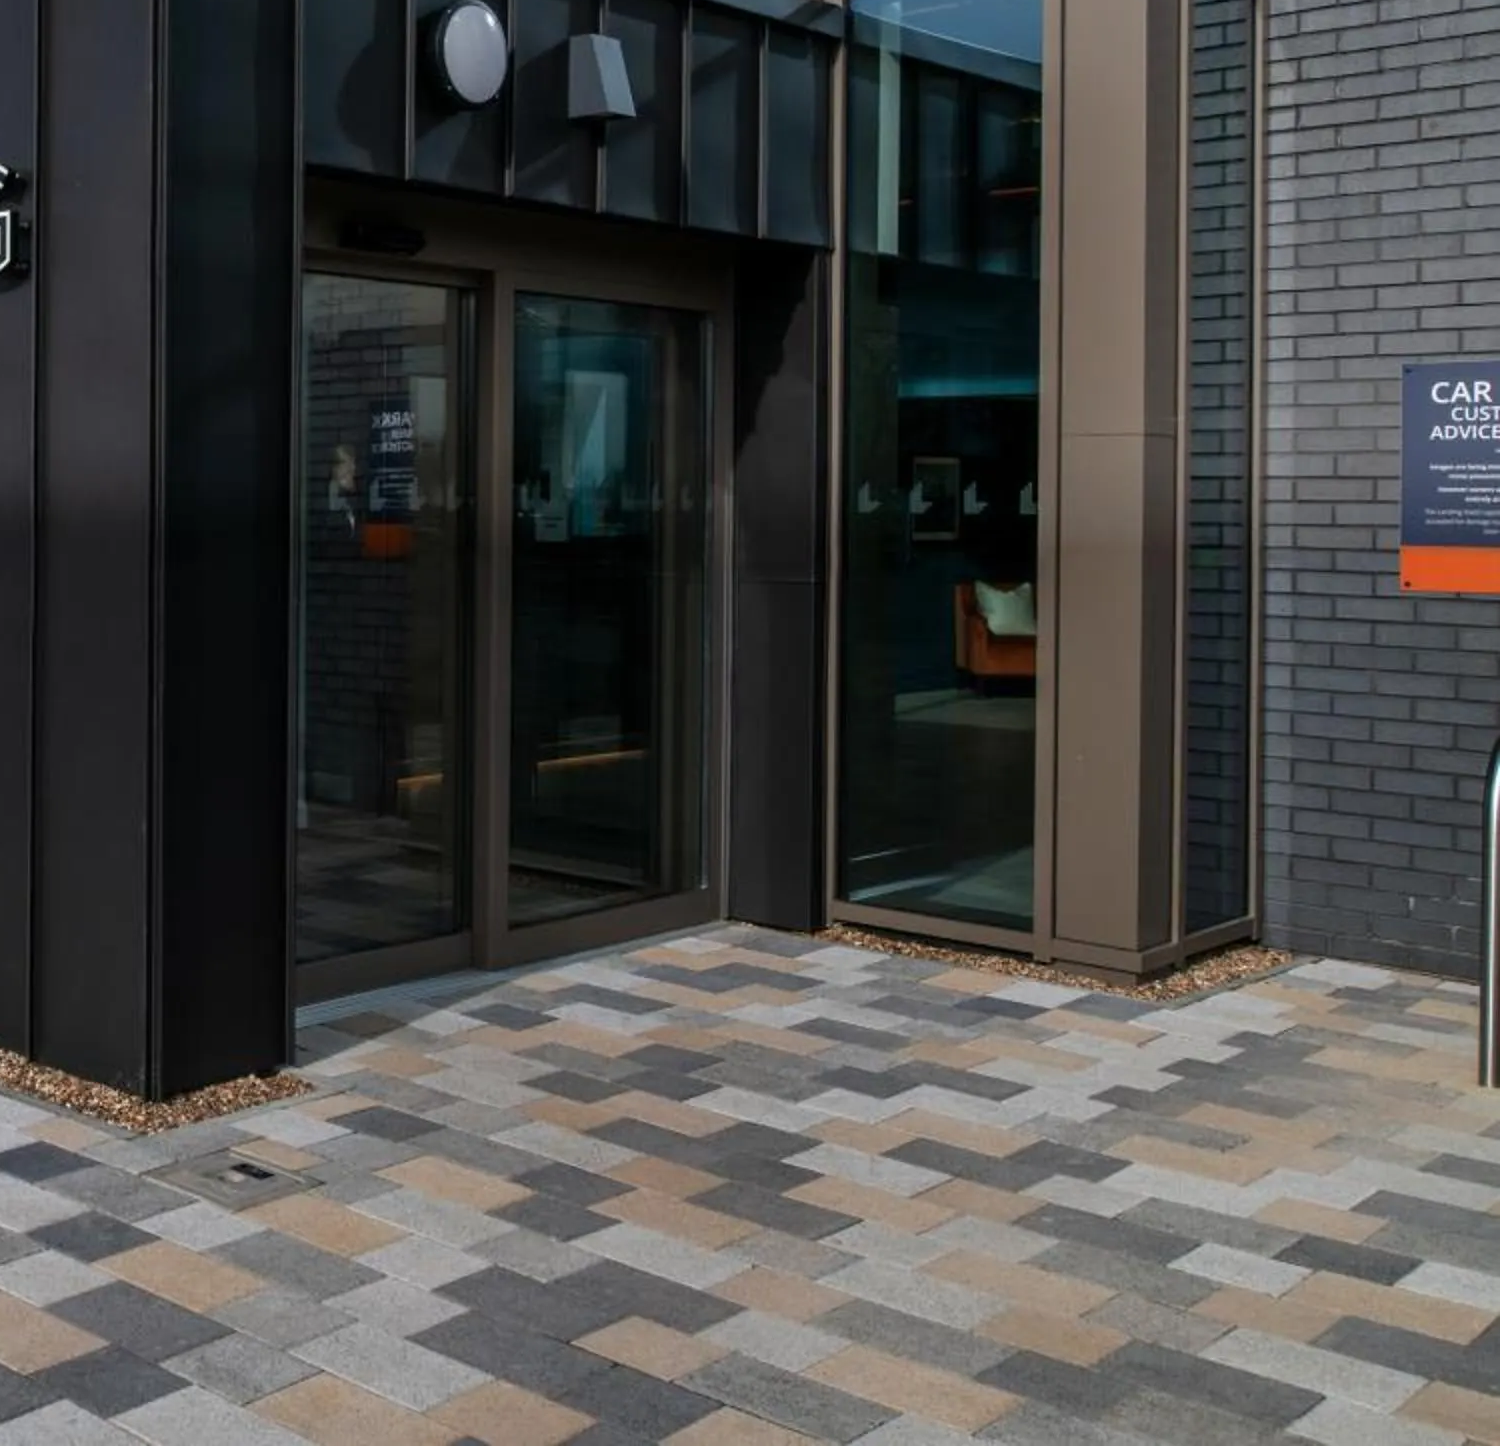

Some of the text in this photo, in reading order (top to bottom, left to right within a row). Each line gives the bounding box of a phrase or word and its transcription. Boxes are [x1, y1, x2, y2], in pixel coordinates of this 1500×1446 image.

[1431, 380, 1493, 404] CAR
[1451, 405, 1500, 422] CUST
[1429, 423, 1500, 441] ADVICE
